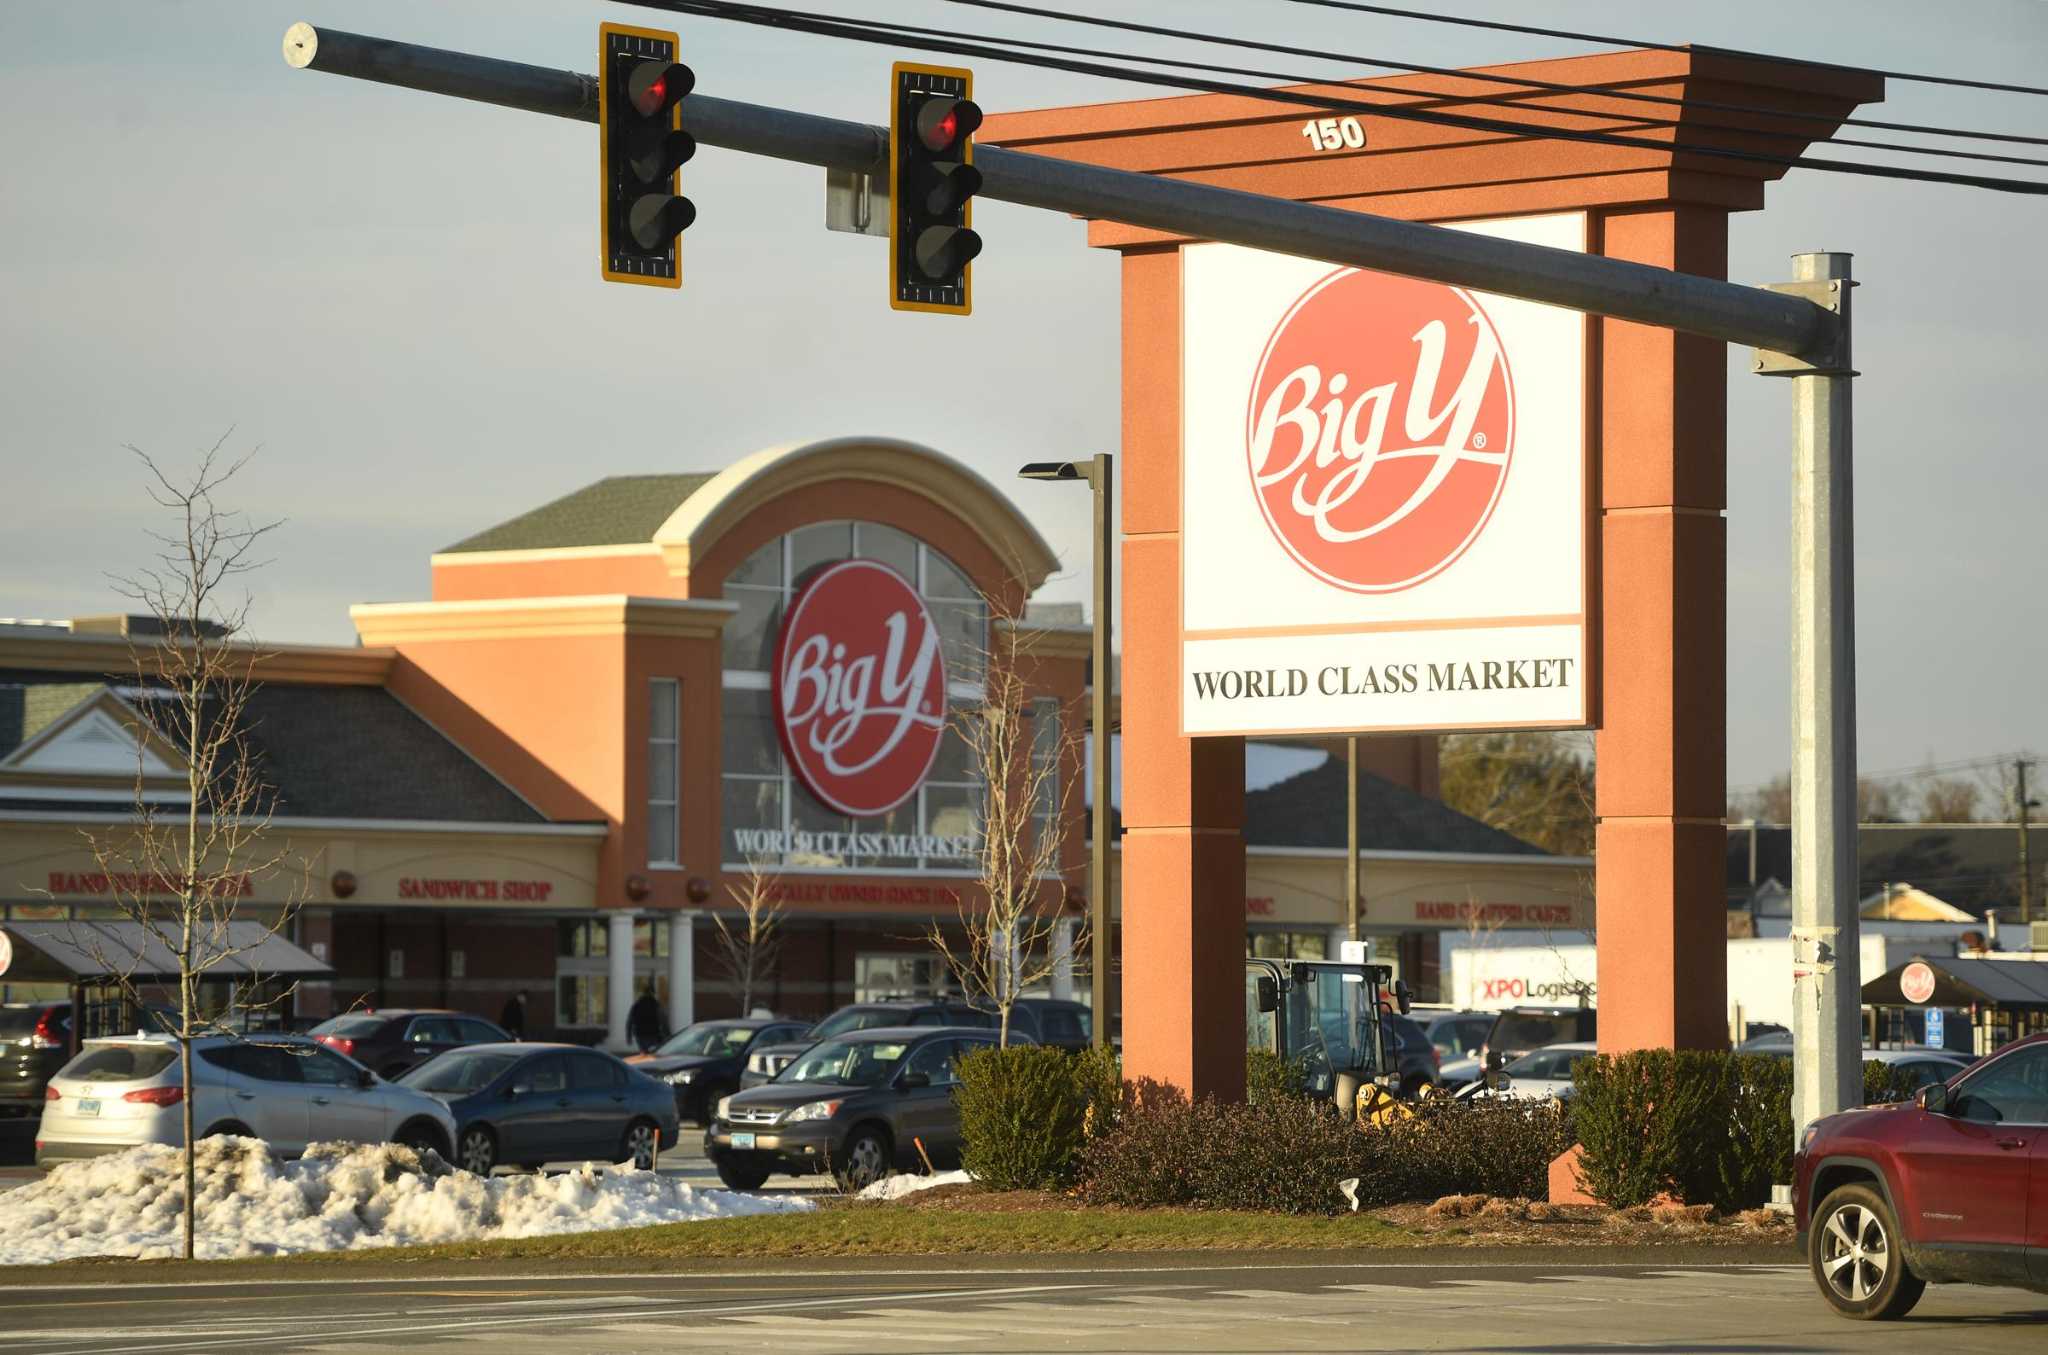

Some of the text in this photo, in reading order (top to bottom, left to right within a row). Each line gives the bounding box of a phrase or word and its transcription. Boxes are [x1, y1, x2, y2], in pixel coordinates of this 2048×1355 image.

[1302, 116, 1366, 151] 150
[1254, 364, 1398, 517] Big
[784, 634, 876, 753] Big
[1192, 658, 1574, 700] WORLD CLASS MARKET
[734, 829, 977, 859] WORLD CLASS MARKET
[399, 878, 553, 902] SANDWICH SHOP
[1483, 979, 1523, 998] XPO
